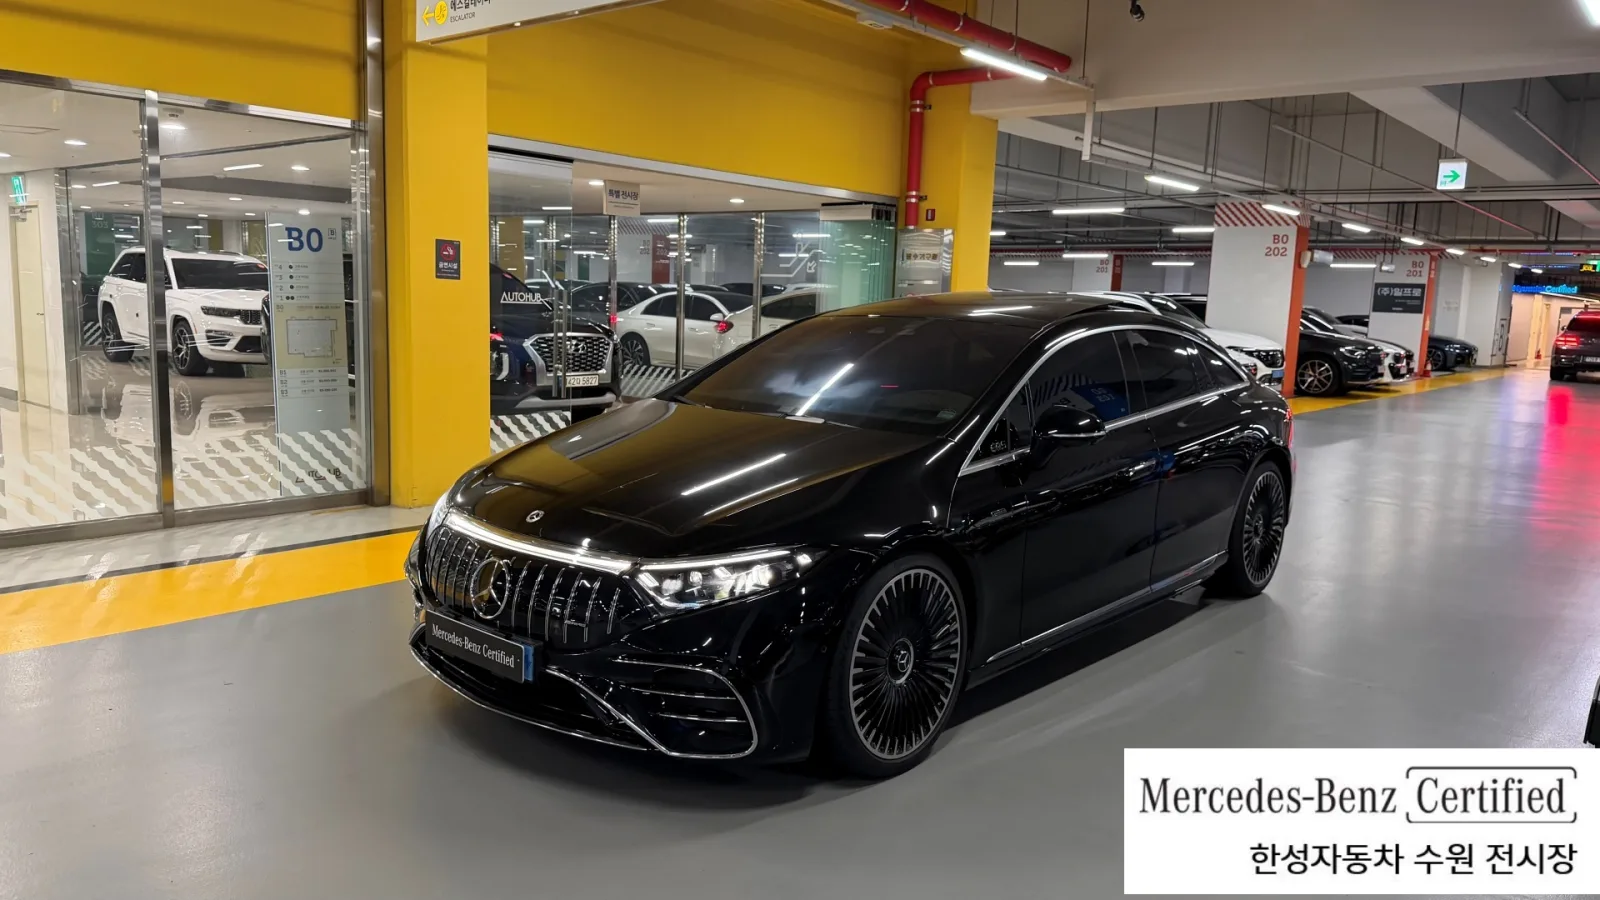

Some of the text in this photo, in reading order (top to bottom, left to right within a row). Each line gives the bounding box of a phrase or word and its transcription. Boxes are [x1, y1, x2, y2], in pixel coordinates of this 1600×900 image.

[450, 12, 476, 23] ESCALATOR
[621, 190, 639, 201] 전시장
[1264, 247, 1288, 257] 202
[1406, 269, 1423, 277] 201
[1545, 283, 1578, 294] Certified
[500, 291, 541, 302] AUTOHUB
[432, 623, 515, 668] Mercedes-Benz Certified
